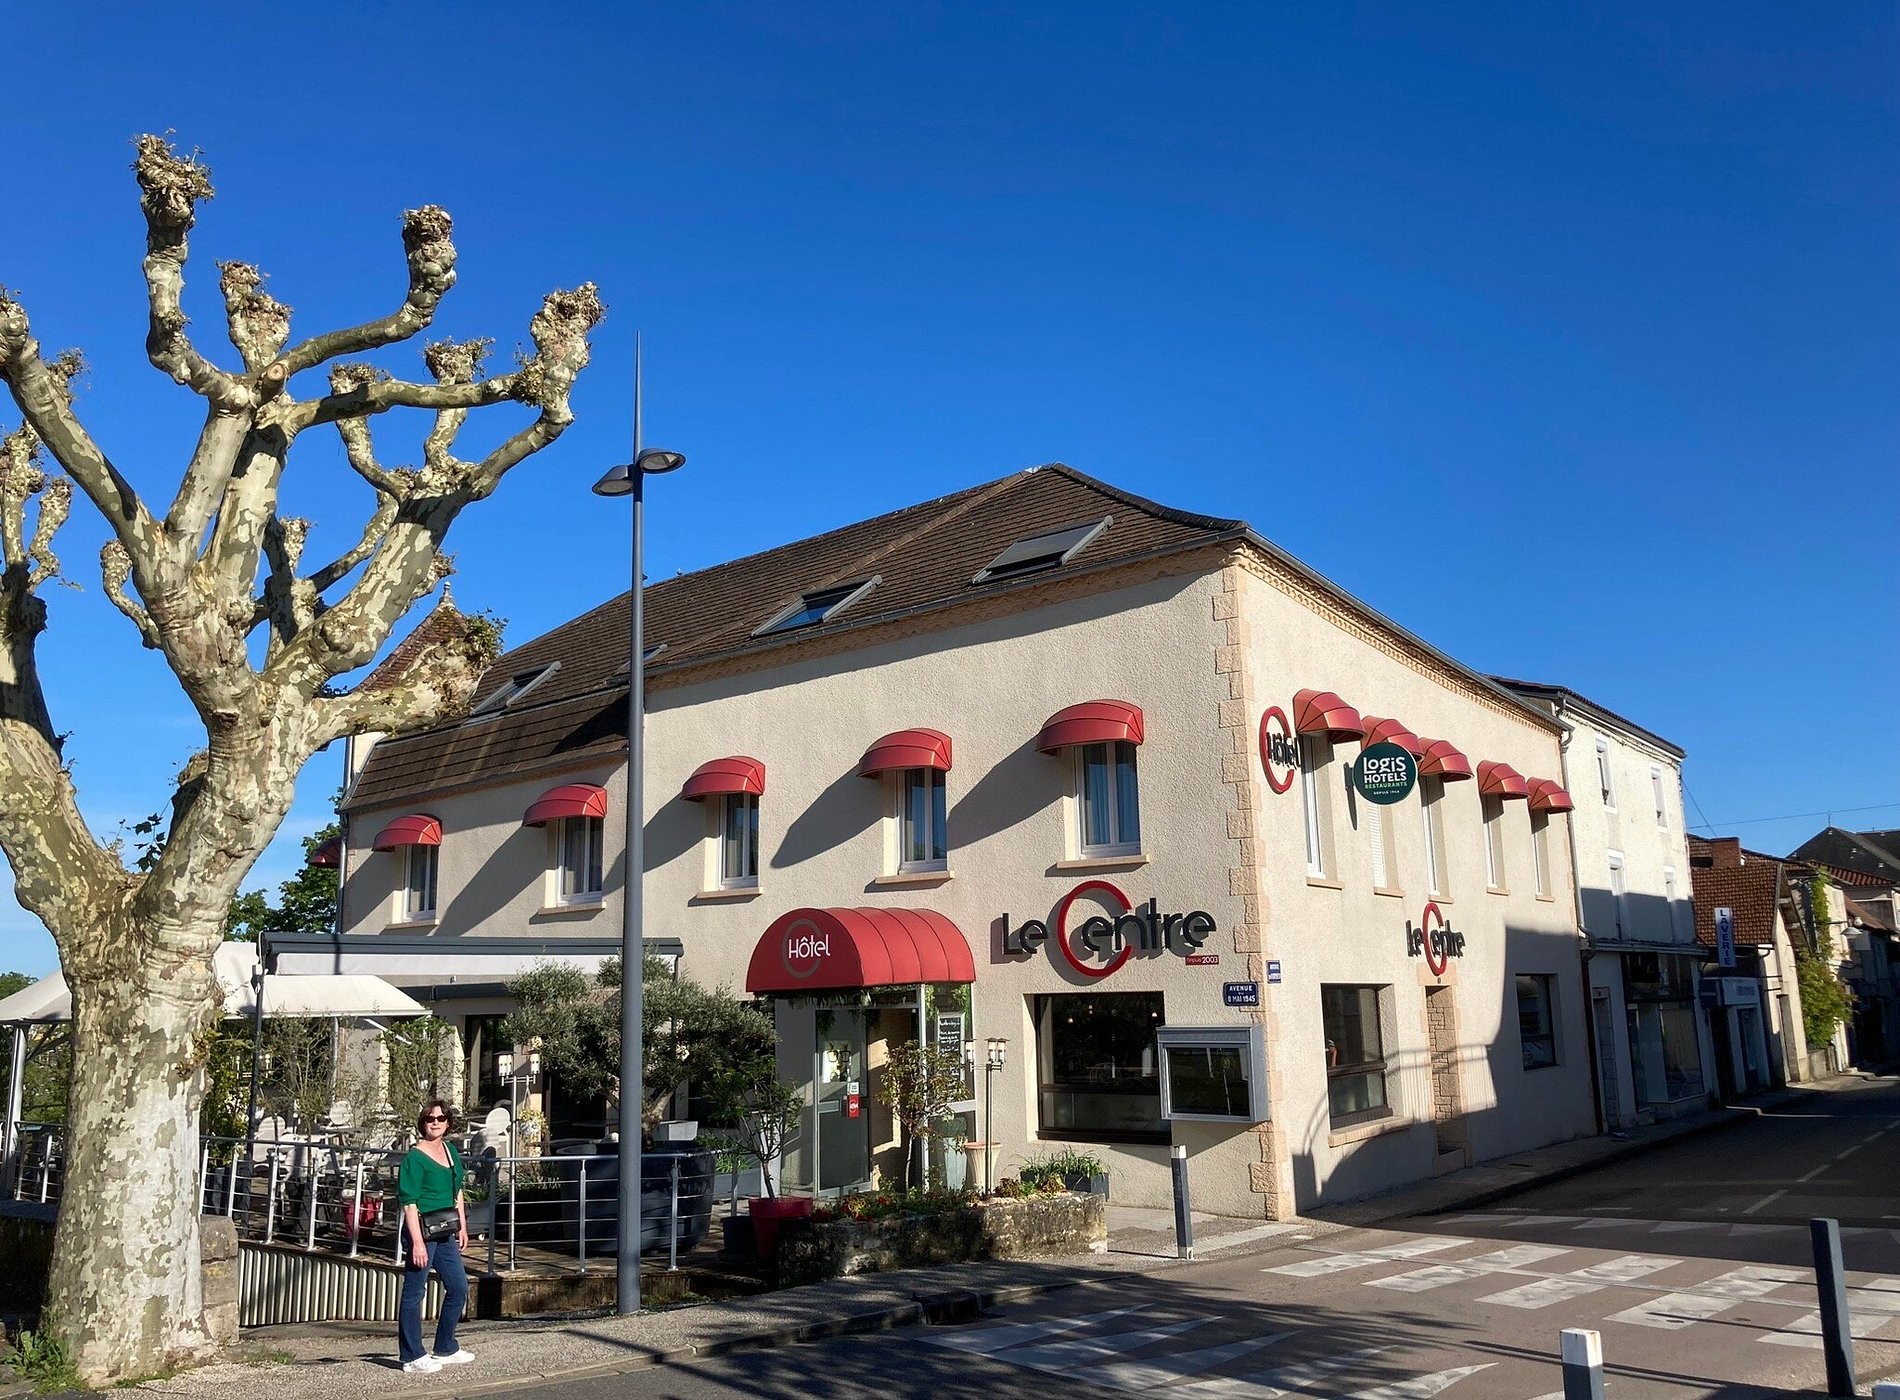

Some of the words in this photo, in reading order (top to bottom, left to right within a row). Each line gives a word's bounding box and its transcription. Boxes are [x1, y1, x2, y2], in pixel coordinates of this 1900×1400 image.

[1364, 772, 1407, 783] HOTELS
[1365, 781, 1407, 789] RESTAURANTS
[1002, 912, 1048, 955] Le
[1057, 880, 1217, 977] Centre
[1423, 903, 1466, 976] Centre
[1720, 909, 1731, 965] LAVERIE
[788, 933, 831, 959] Hôtel
[1202, 956, 1218, 964] 2003
